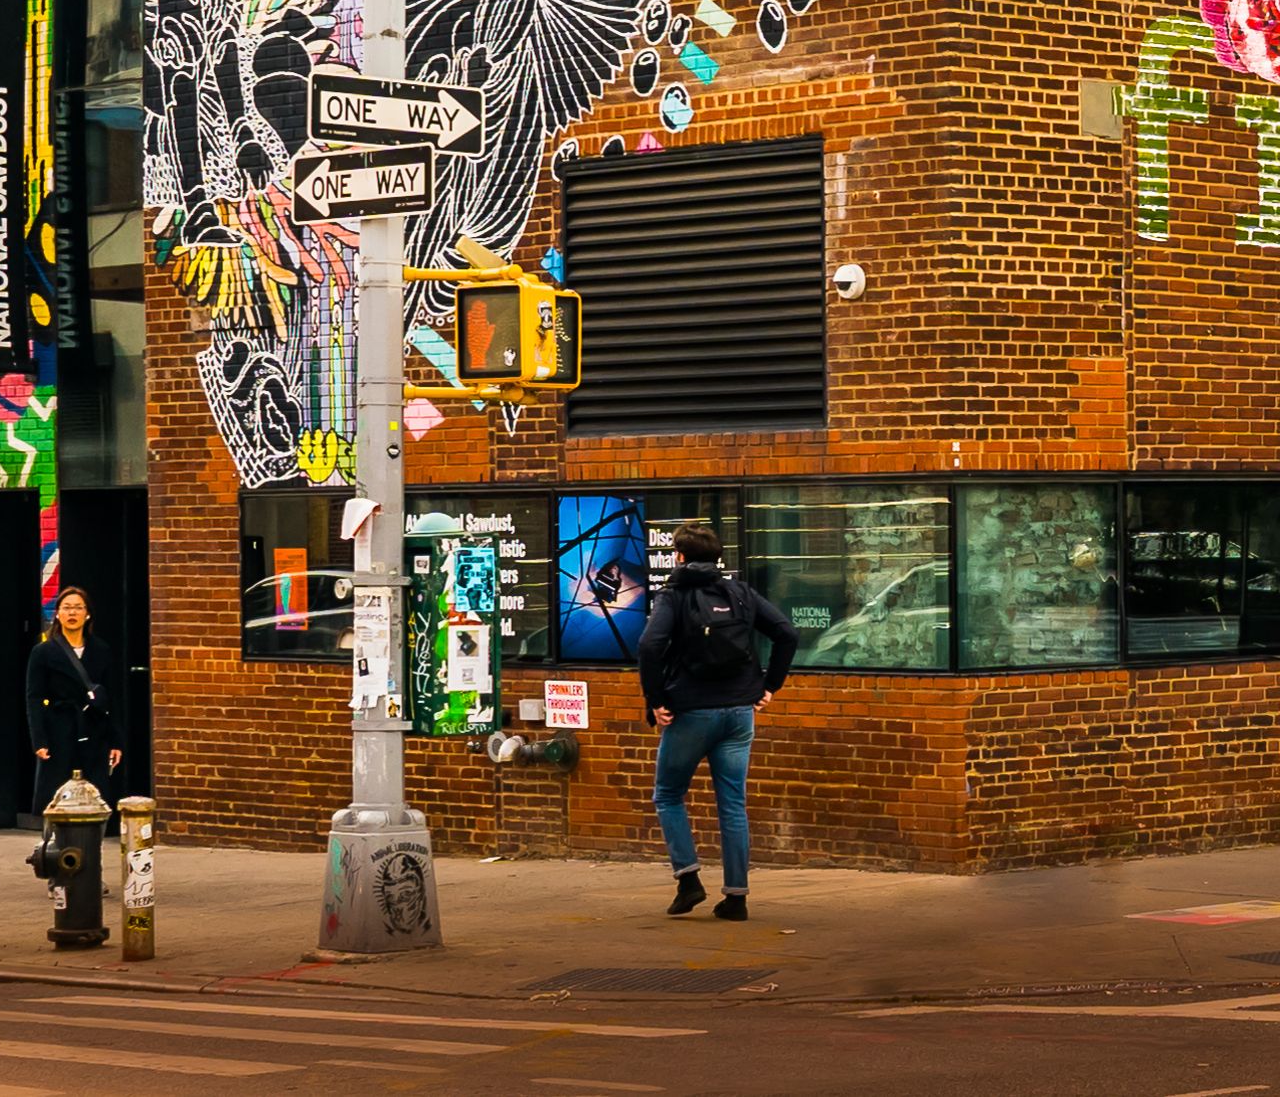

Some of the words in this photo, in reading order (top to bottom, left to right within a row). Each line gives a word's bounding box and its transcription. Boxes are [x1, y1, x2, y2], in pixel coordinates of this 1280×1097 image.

[327, 96, 377, 124] ONE
[407, 103, 459, 132] WAY
[312, 174, 352, 201] ONE
[376, 167, 419, 195] WAY
[466, 513, 516, 534] Sawdust,
[792, 607, 831, 617] NATIONAL
[792, 617, 831, 628] SAWDUST
